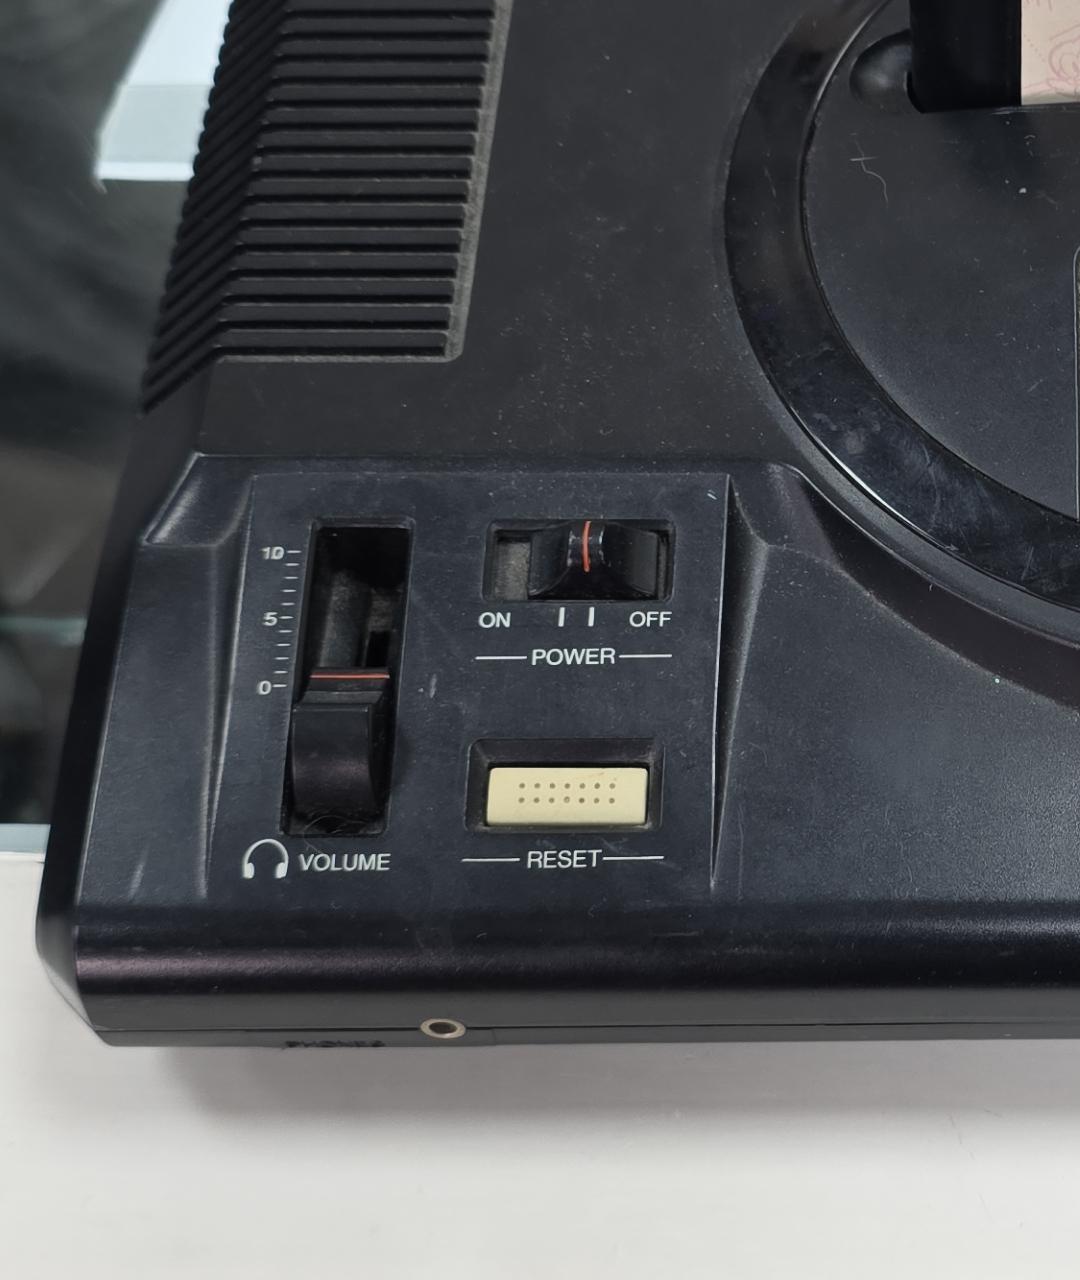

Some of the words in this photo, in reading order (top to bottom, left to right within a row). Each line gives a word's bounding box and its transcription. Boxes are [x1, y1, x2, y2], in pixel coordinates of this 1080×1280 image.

[261, 545, 286, 562] 10
[263, 611, 279, 627] 5
[478, 611, 512, 629] ON
[628, 610, 673, 629] OFF
[530, 647, 617, 667] POWER
[256, 680, 273, 697] 0
[299, 852, 392, 873] VOLUME
[526, 849, 603, 870] RESET
